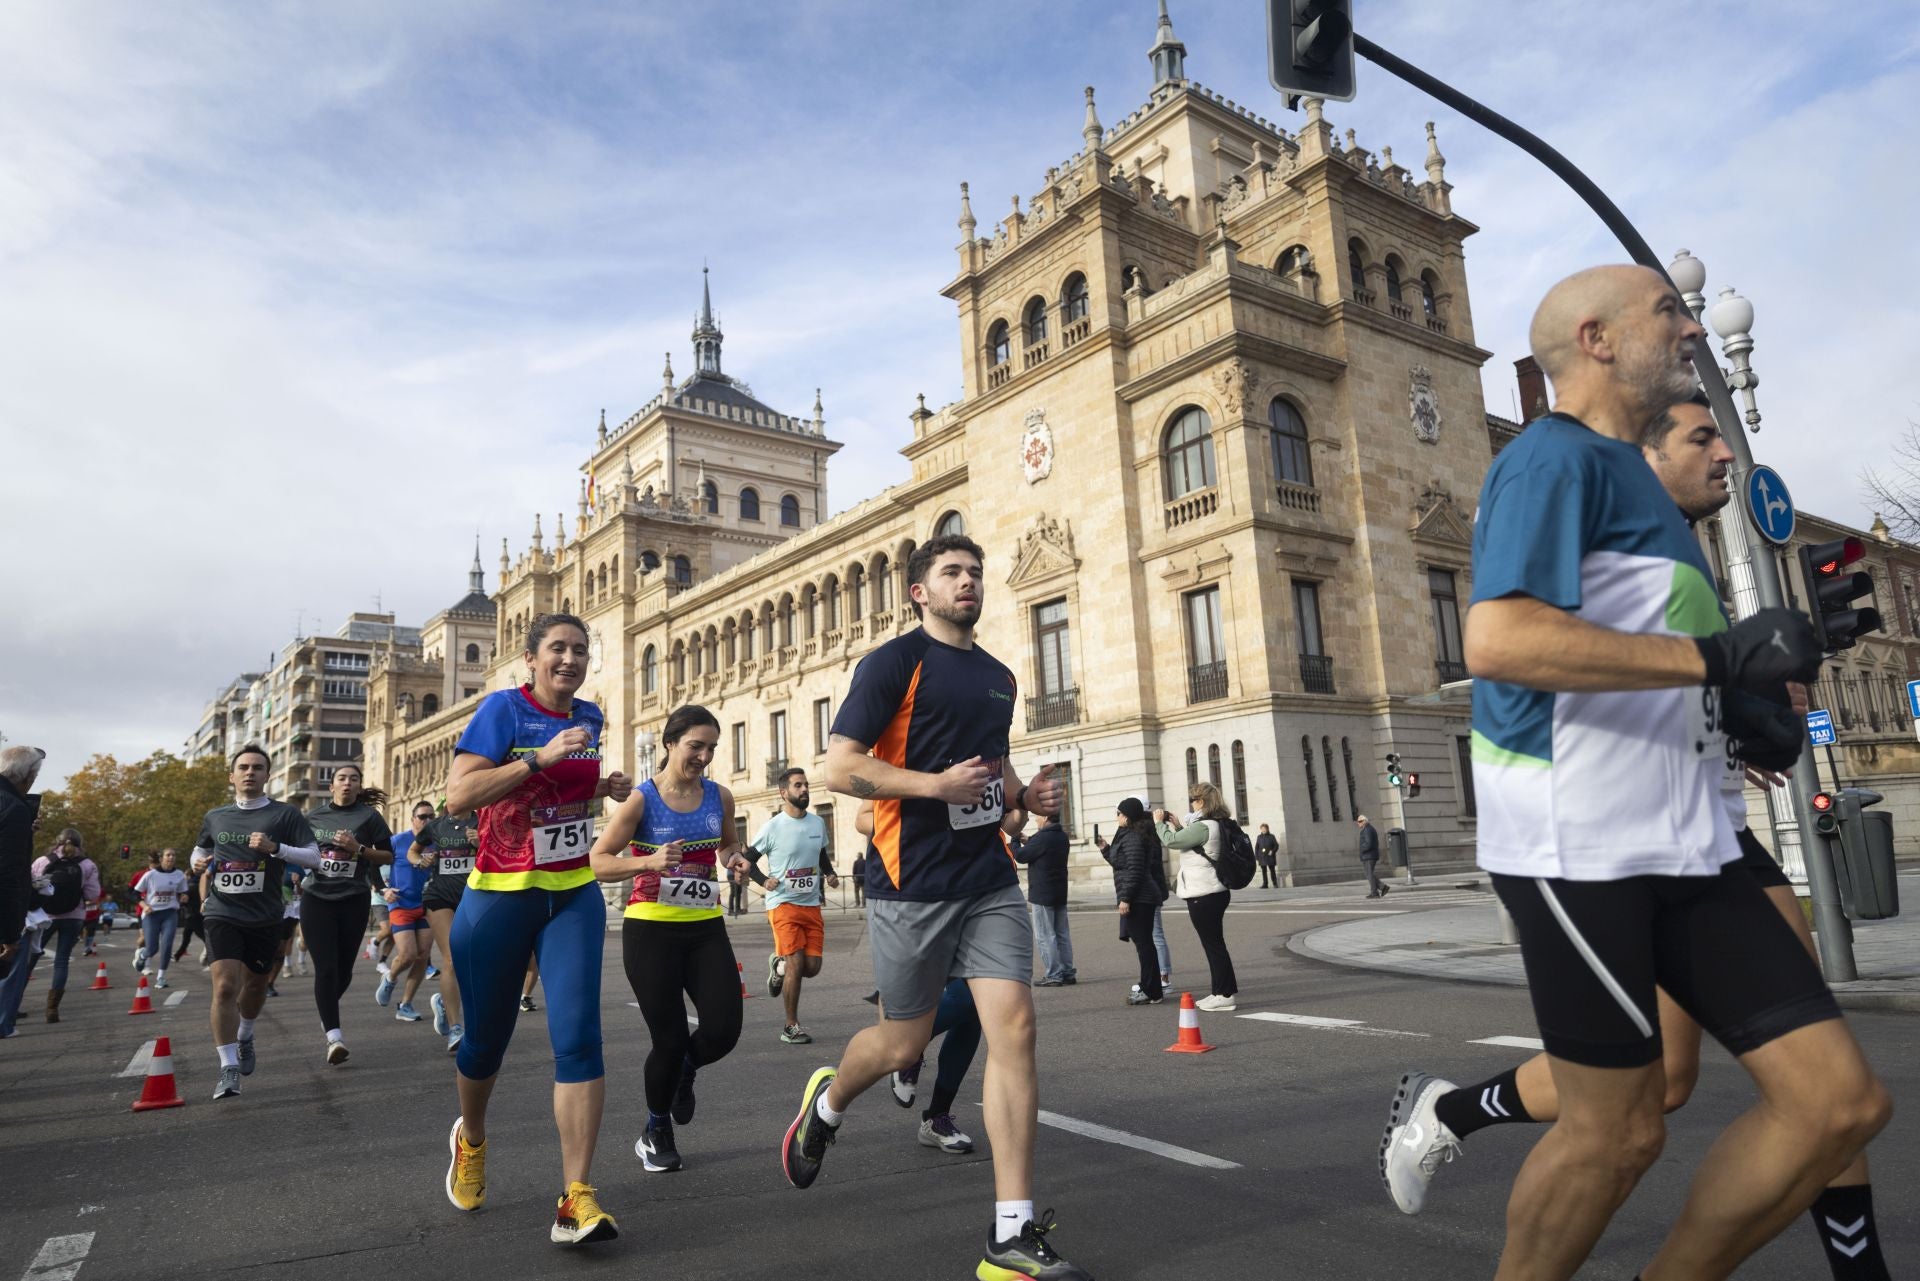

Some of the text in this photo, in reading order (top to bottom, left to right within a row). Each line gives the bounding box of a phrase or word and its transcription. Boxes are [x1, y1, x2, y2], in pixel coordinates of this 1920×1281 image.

[1810, 729, 1830, 740] TAXI
[544, 822, 588, 851] 751
[322, 860, 350, 872] 902
[444, 858, 468, 869] 901
[221, 873, 256, 887] 903
[790, 877, 813, 888] 786
[670, 879, 711, 899] 749
